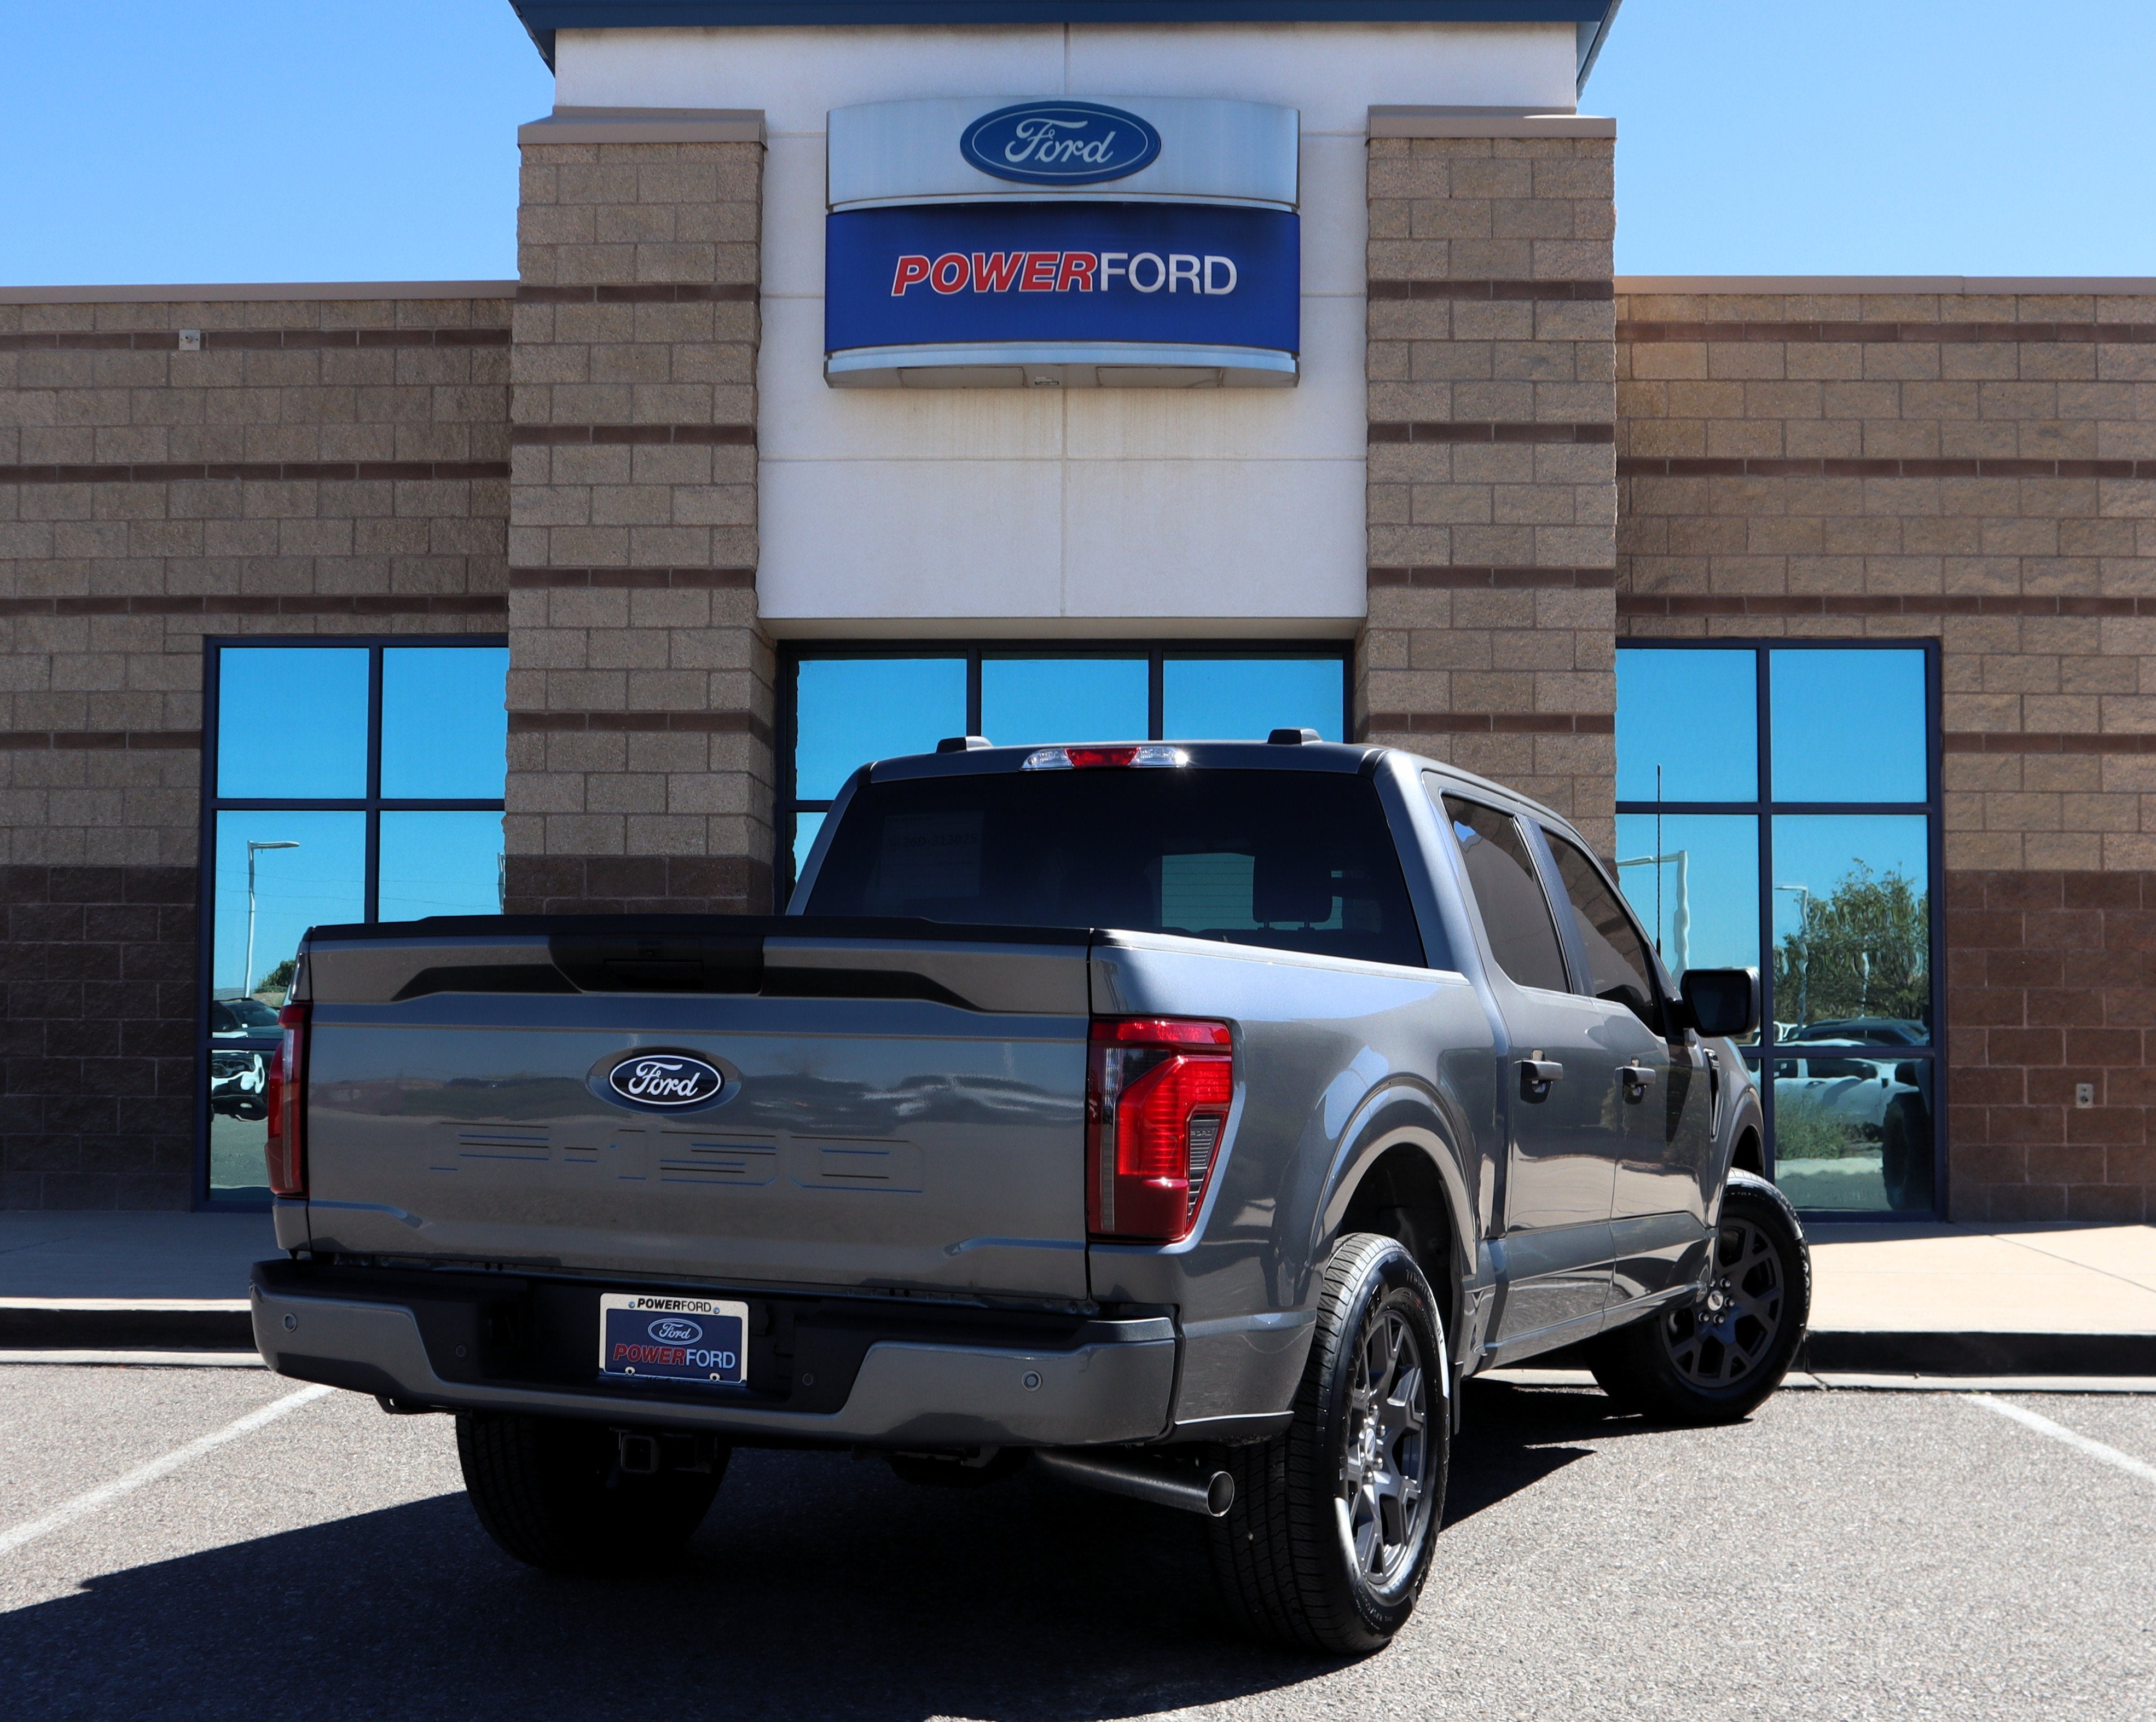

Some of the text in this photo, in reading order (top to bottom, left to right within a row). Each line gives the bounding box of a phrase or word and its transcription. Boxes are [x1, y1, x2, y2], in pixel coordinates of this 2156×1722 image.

[1005, 118, 1115, 164] Ford
[891, 251, 1238, 297] POWERFORD
[629, 1061, 700, 1096] Ford
[637, 1298, 711, 1312] POWERFORD
[659, 1322, 691, 1339] Ford
[613, 1344, 735, 1368] POWERFORD
